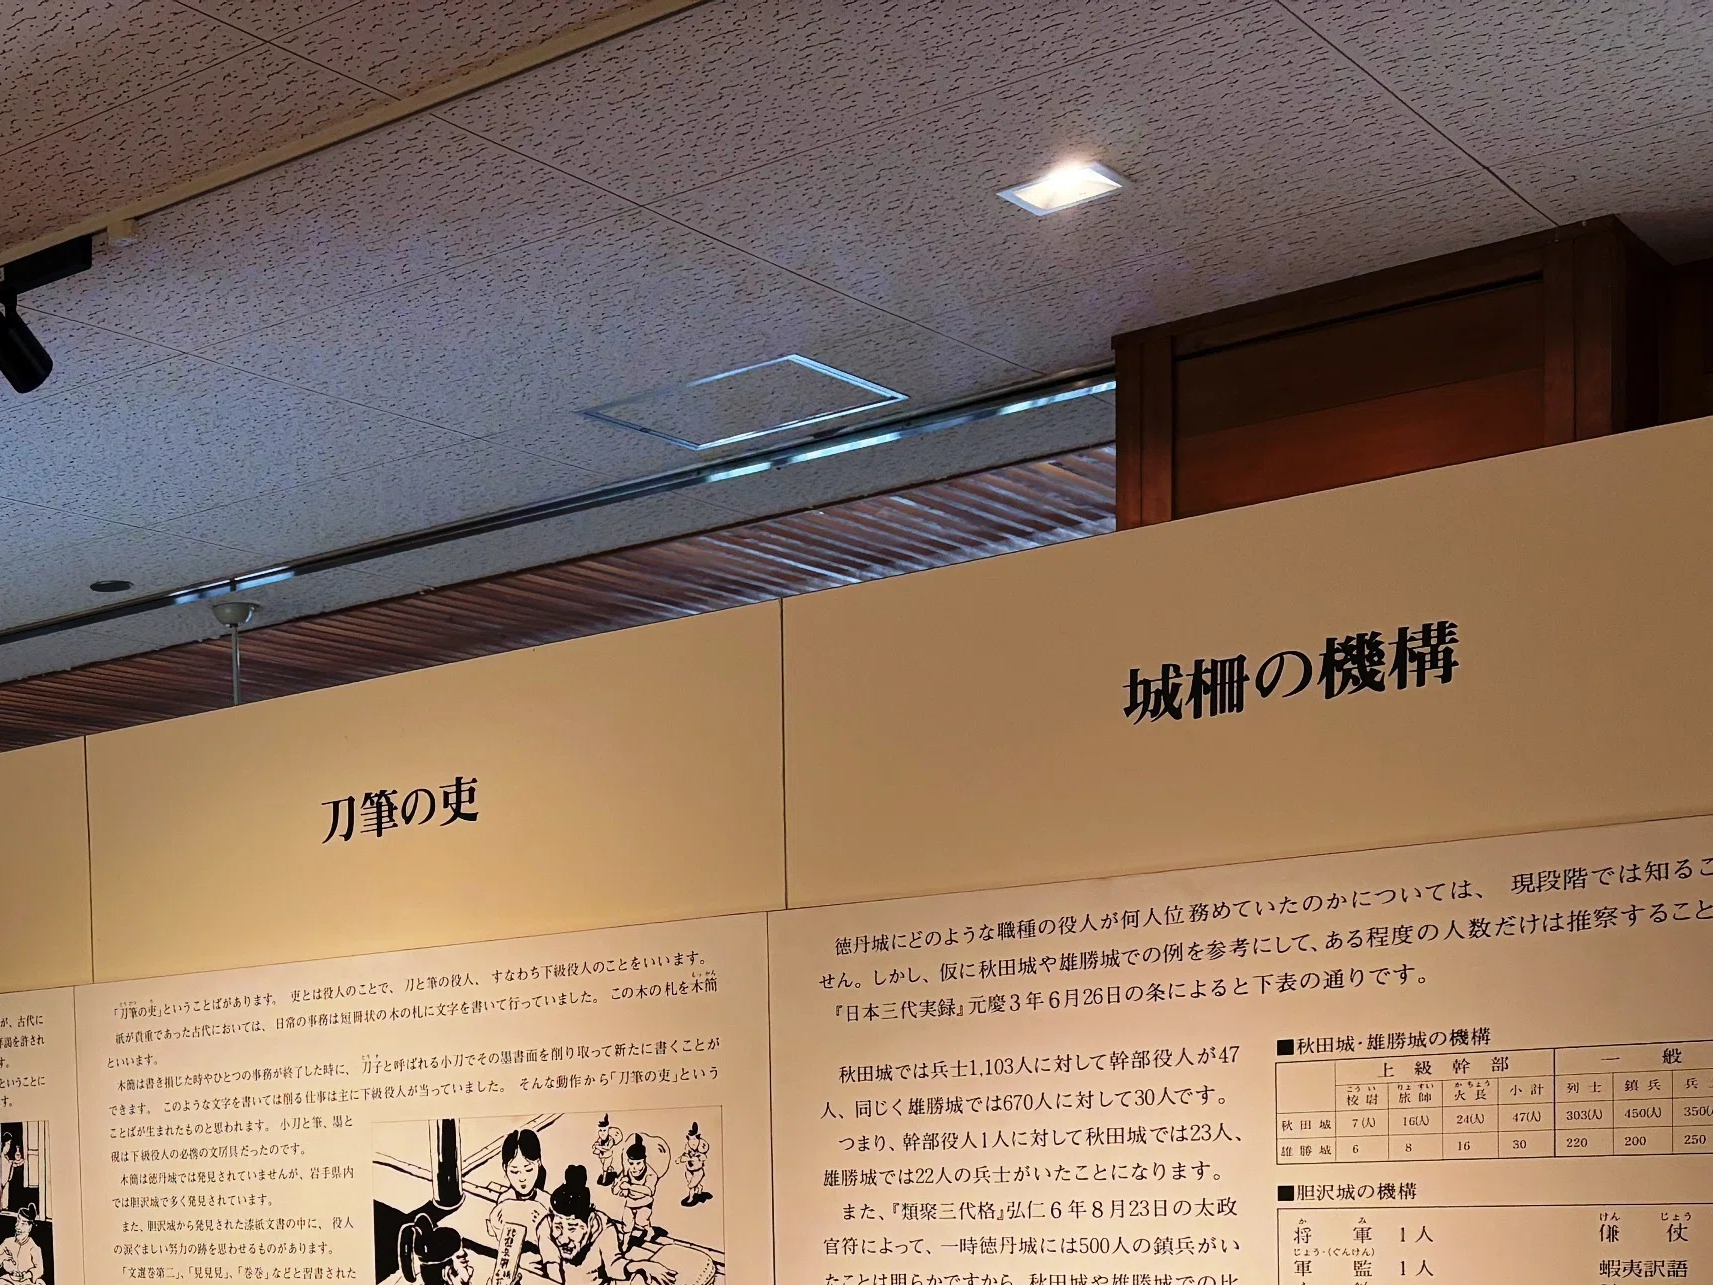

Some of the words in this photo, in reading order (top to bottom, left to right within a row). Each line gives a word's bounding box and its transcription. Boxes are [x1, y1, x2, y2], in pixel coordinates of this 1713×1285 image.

[1123, 620, 1460, 725] 城柵の機構
[321, 776, 479, 844] 刀筆の吏
[107, 1053, 158, 1068] といいます。
[1510, 1083, 1544, 1096] 小計
[1624, 1079, 1661, 1092] 鎮兵
[1352, 1144, 1359, 1153] 6
[1405, 1143, 1412, 1152] 8
[1457, 1140, 1470, 1151] 16
[1512, 1139, 1527, 1150] 30
[1566, 1137, 1588, 1148] 220
[1624, 1136, 1647, 1146] 200
[1684, 1134, 1707, 1145] 250
[824, 1161, 1222, 1188] 雄勝城では22人の兵士がいたことになります。
[1296, 1182, 1417, 1201] 胆沢城の機構
[1599, 1260, 1688, 1278] 蝦夷訳語
